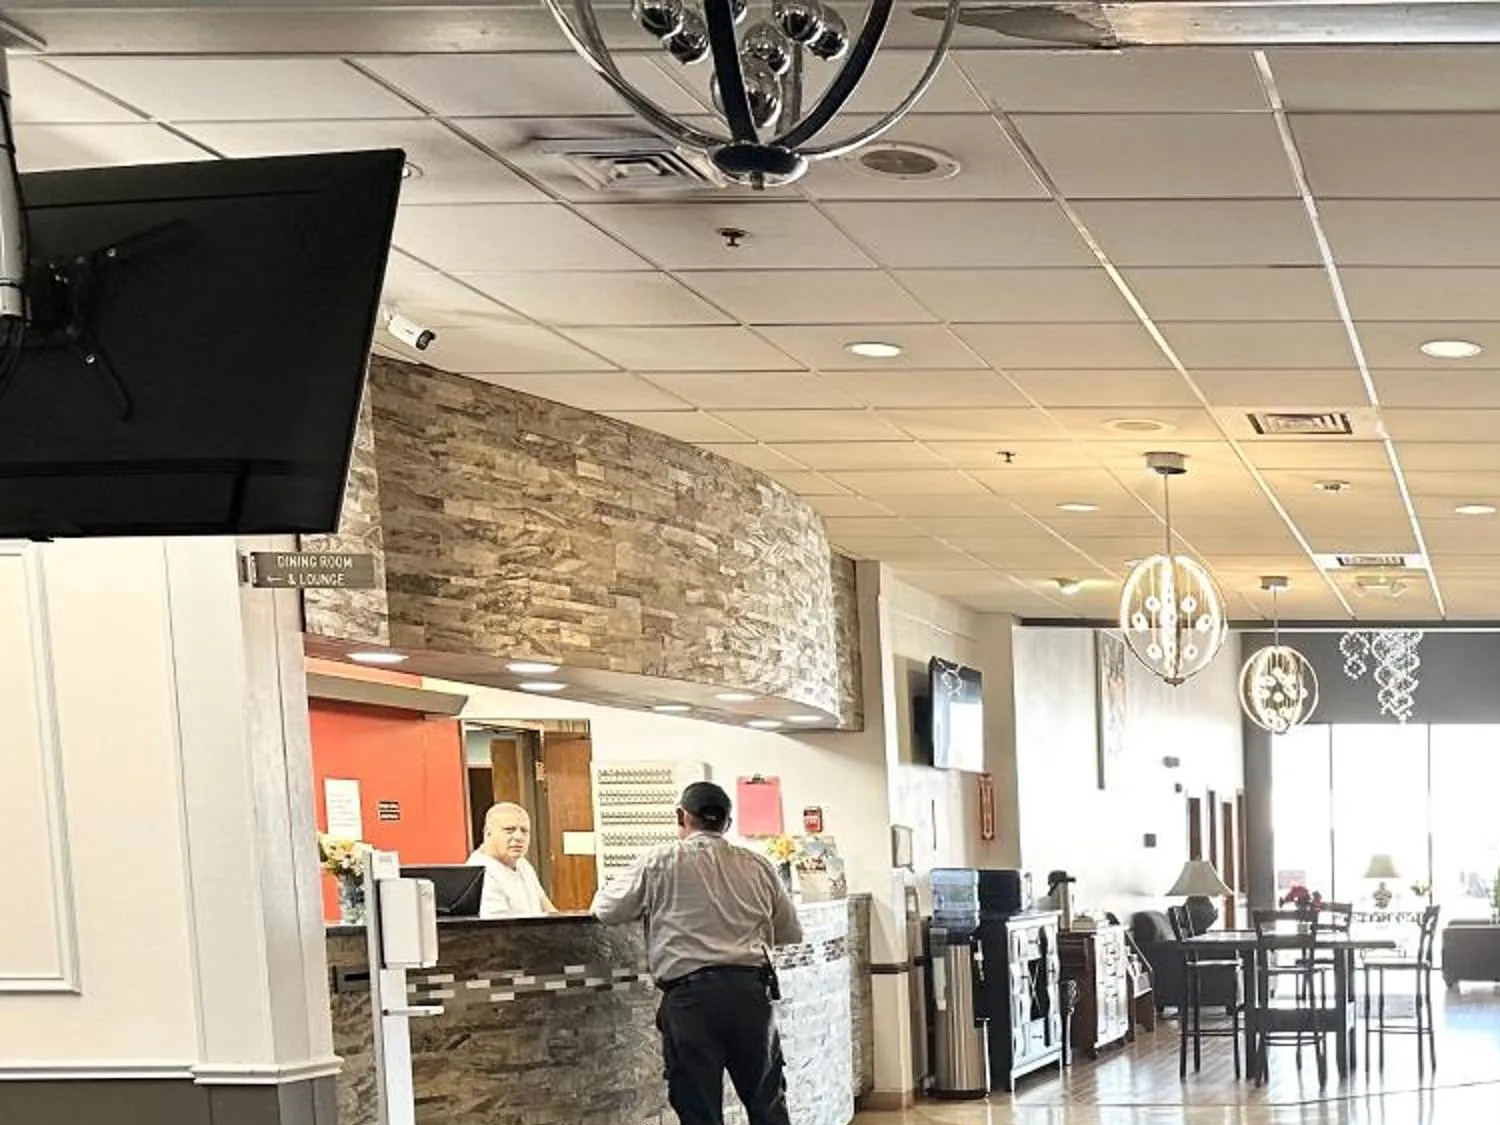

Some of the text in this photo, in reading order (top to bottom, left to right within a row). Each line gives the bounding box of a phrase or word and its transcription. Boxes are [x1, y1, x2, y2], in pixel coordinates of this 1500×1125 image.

[277, 555, 353, 568] DINING ROOM
[287, 573, 345, 585] & LOUNGE
